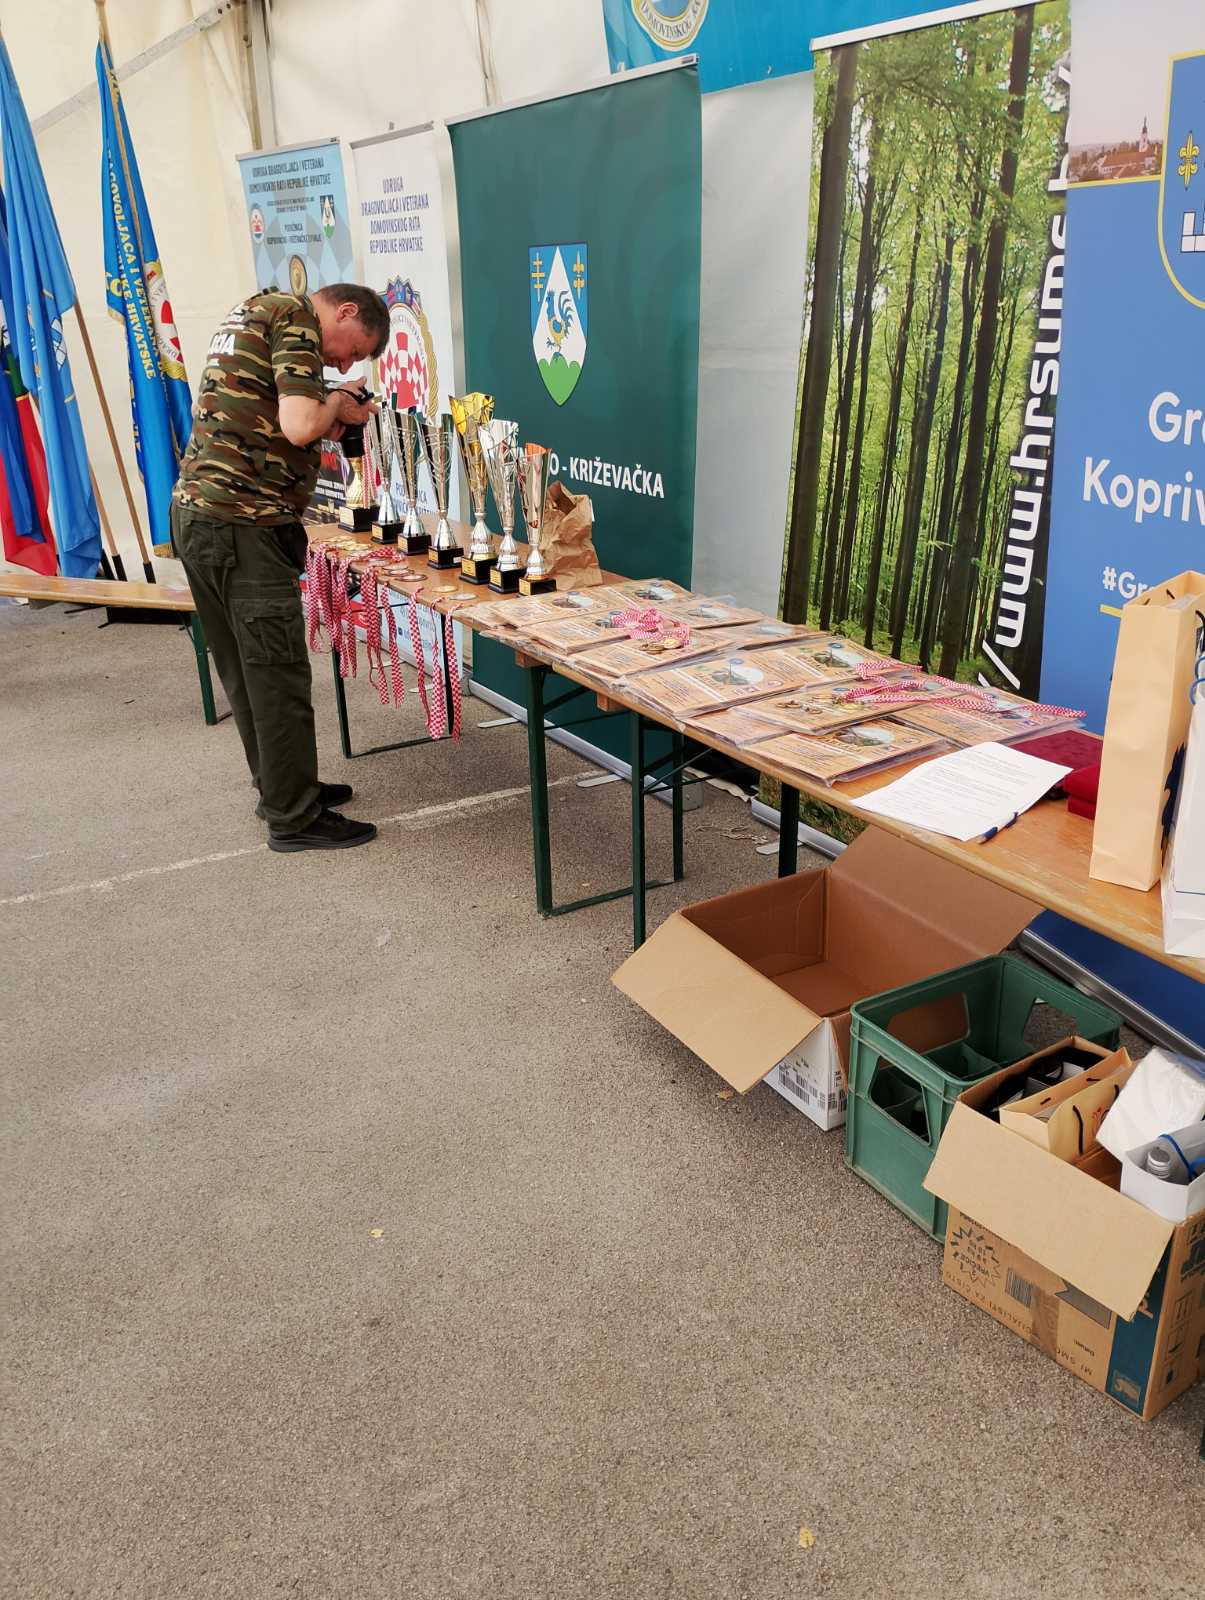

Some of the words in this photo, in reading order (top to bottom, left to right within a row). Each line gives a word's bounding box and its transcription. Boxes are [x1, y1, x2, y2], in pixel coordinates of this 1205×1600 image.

[383, 176, 403, 194] UDRUGA
[361, 198, 400, 217] DRAGOVOLJACA
[402, 193, 429, 212] VETERANA
[370, 217, 408, 235] DOMOVINSKOG
[369, 238, 398, 254] REPUBLIKE
[398, 236, 424, 252] HRVATSKE
[126, 302, 157, 380] HRVATSKE
[1148, 391, 1205, 446] Gr
[569, 455, 665, 499] KRIŽEVAČKA
[1102, 566, 1158, 600] #Gr
